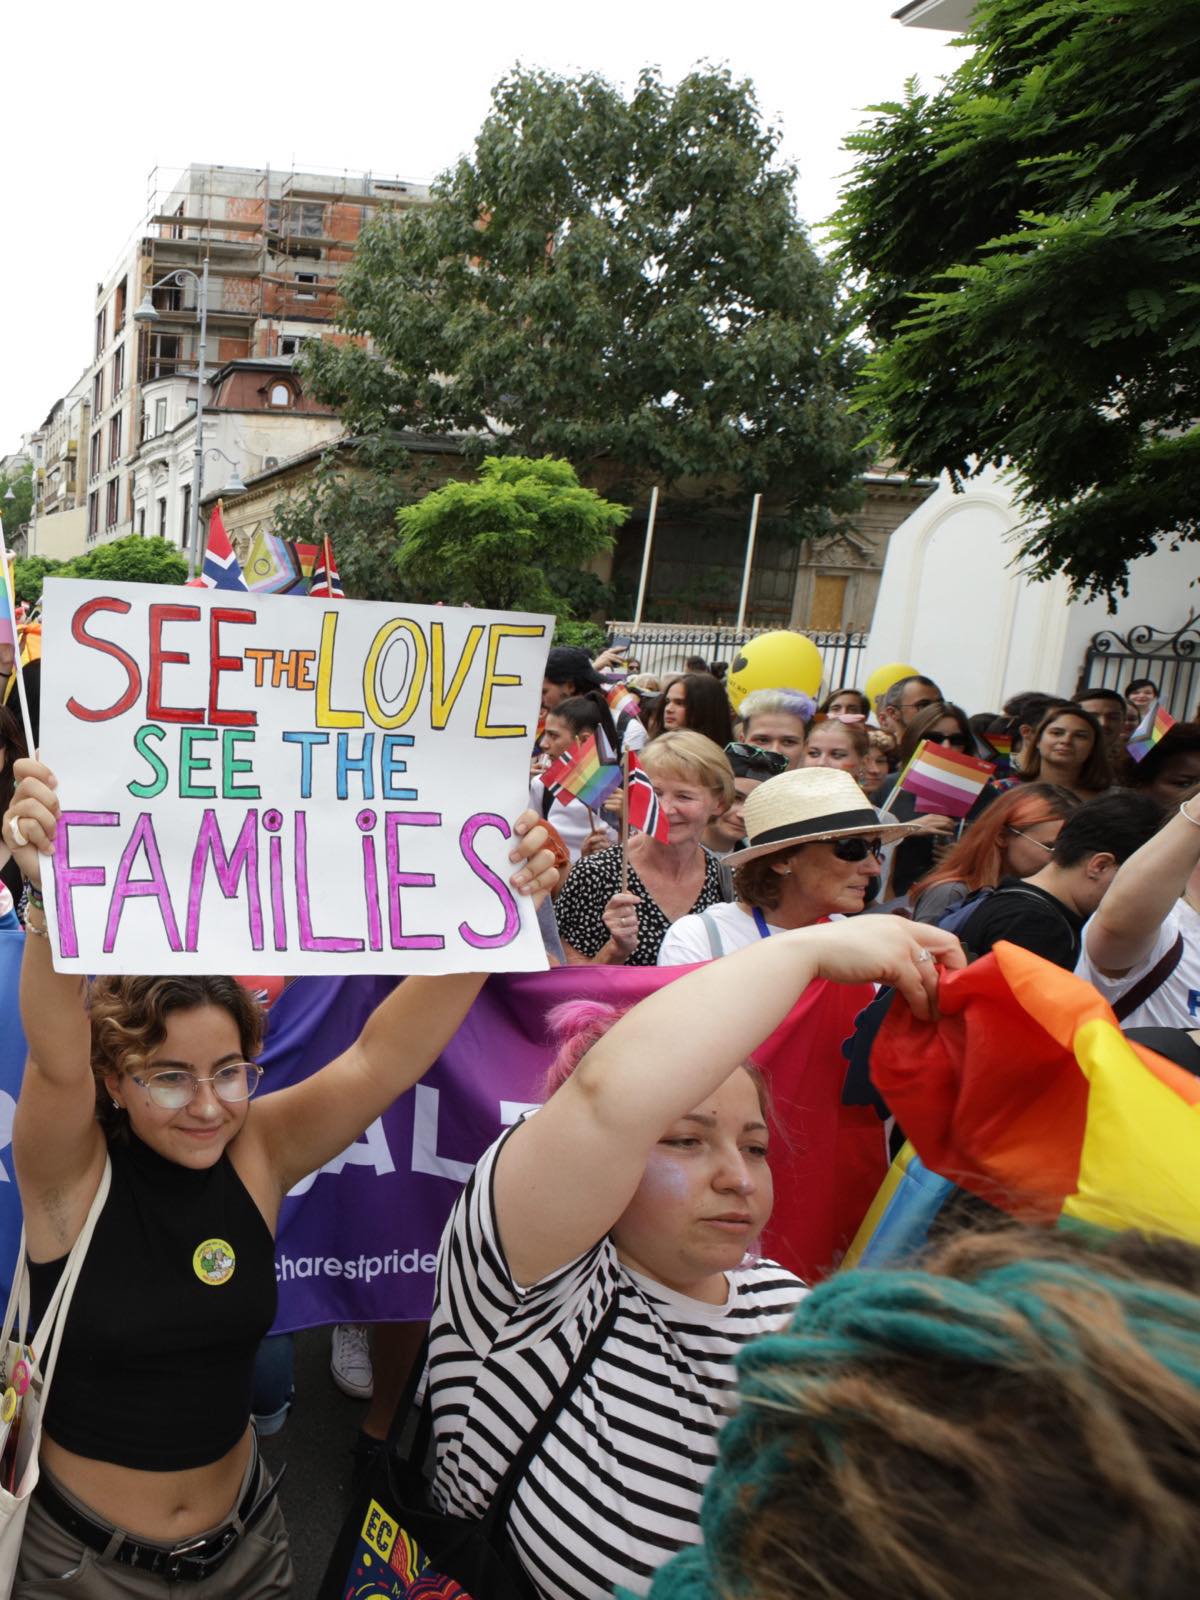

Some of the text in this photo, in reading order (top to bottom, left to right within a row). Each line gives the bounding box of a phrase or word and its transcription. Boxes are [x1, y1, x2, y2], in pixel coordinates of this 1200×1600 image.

[65, 596, 546, 738] SEE THE LOVE
[127, 724, 418, 800] SEE THE
